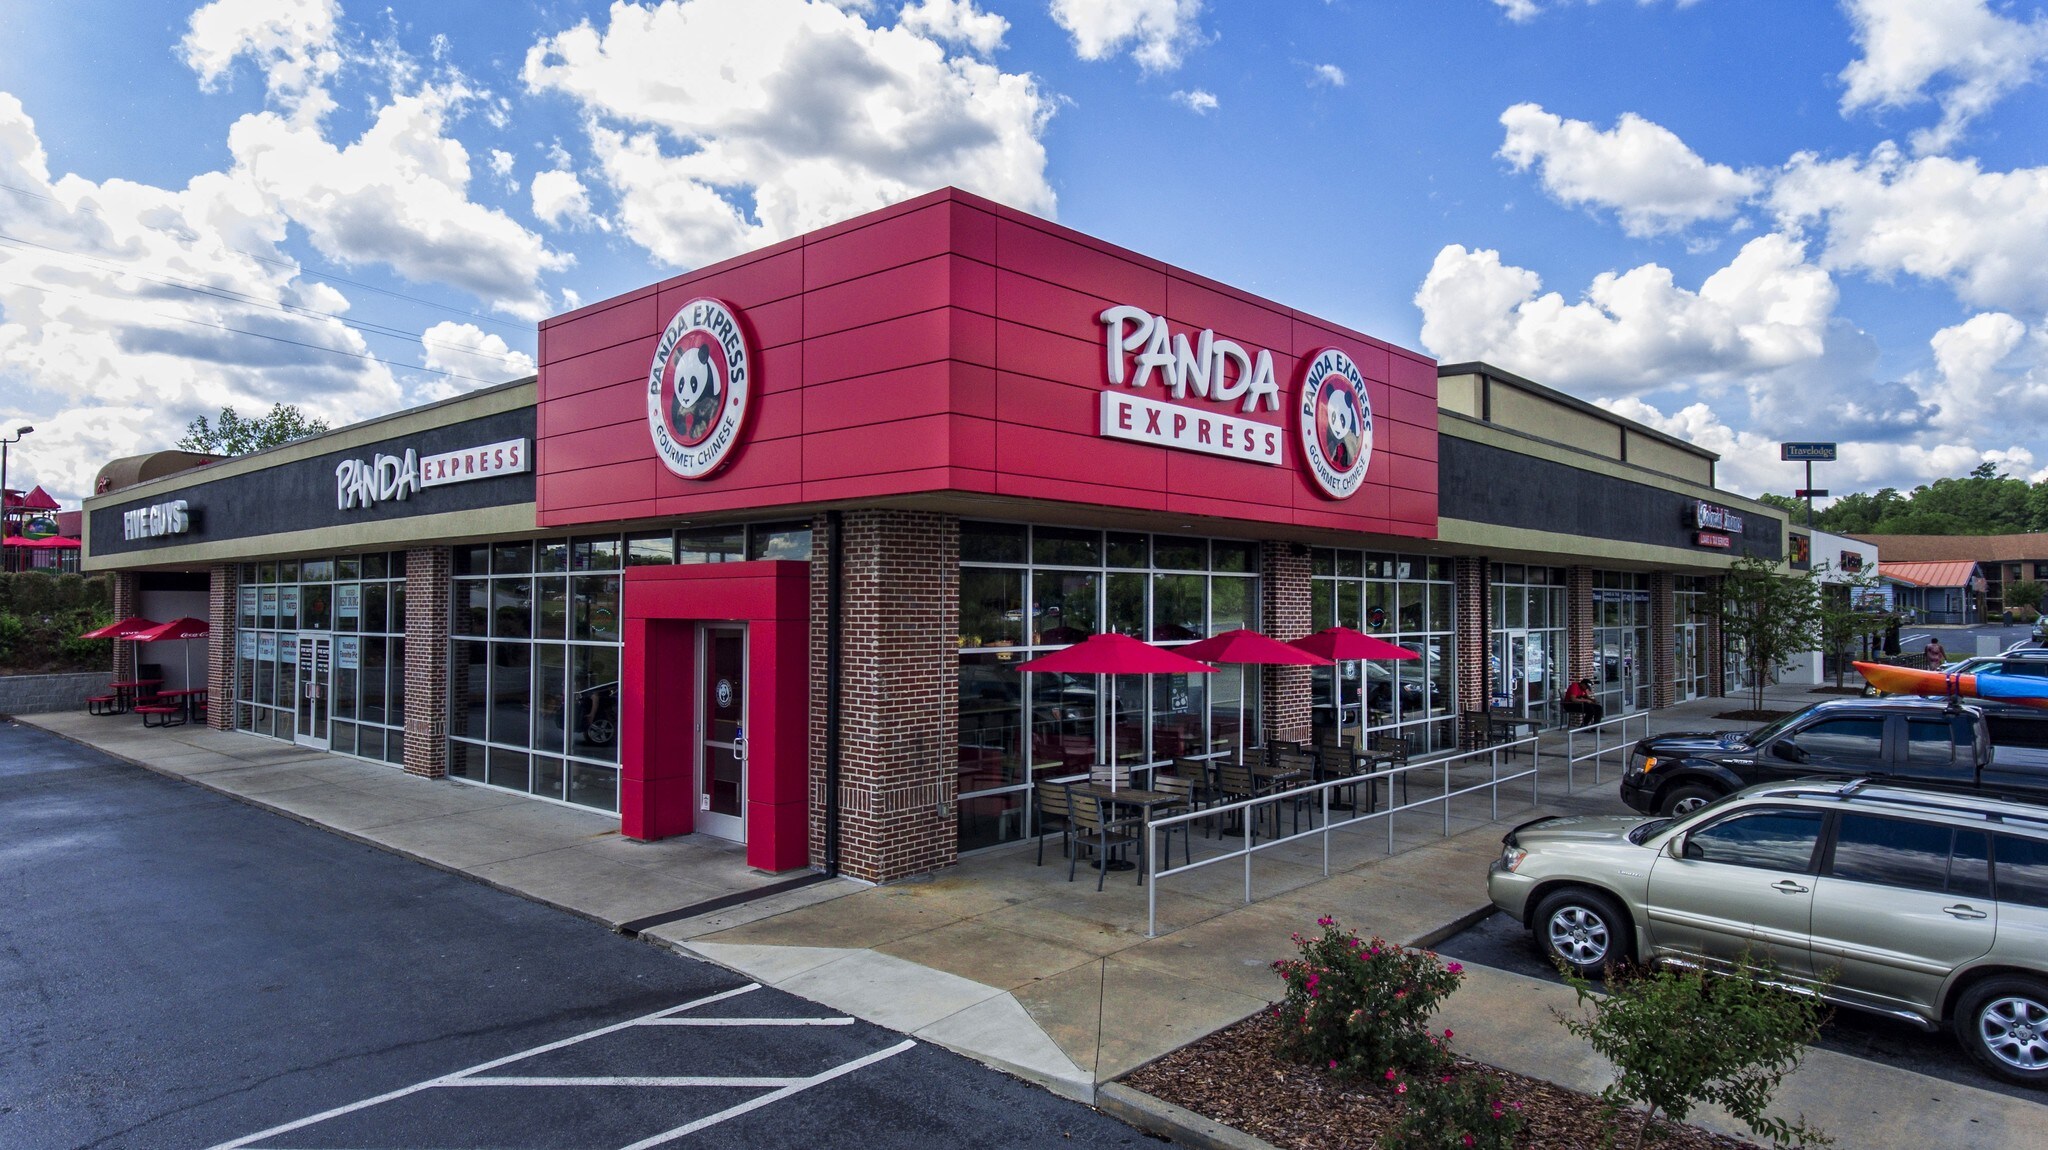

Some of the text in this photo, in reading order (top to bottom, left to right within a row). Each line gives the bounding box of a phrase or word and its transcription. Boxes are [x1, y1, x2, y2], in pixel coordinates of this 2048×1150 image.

[650, 305, 745, 395] PANDA EXPRESS
[1100, 305, 1280, 413] PANDA
[1304, 353, 1371, 432] PANDA EXPRESS
[656, 415, 735, 469] GOURMET CHINESE
[1119, 402, 1276, 456] EXPRESS
[1789, 446, 1833, 457] Travelodge
[336, 446, 519, 510] PANDA EXPRESS
[1309, 444, 1366, 490] GOURMET CHINESE
[124, 500, 189, 540] FIVE GUYS
